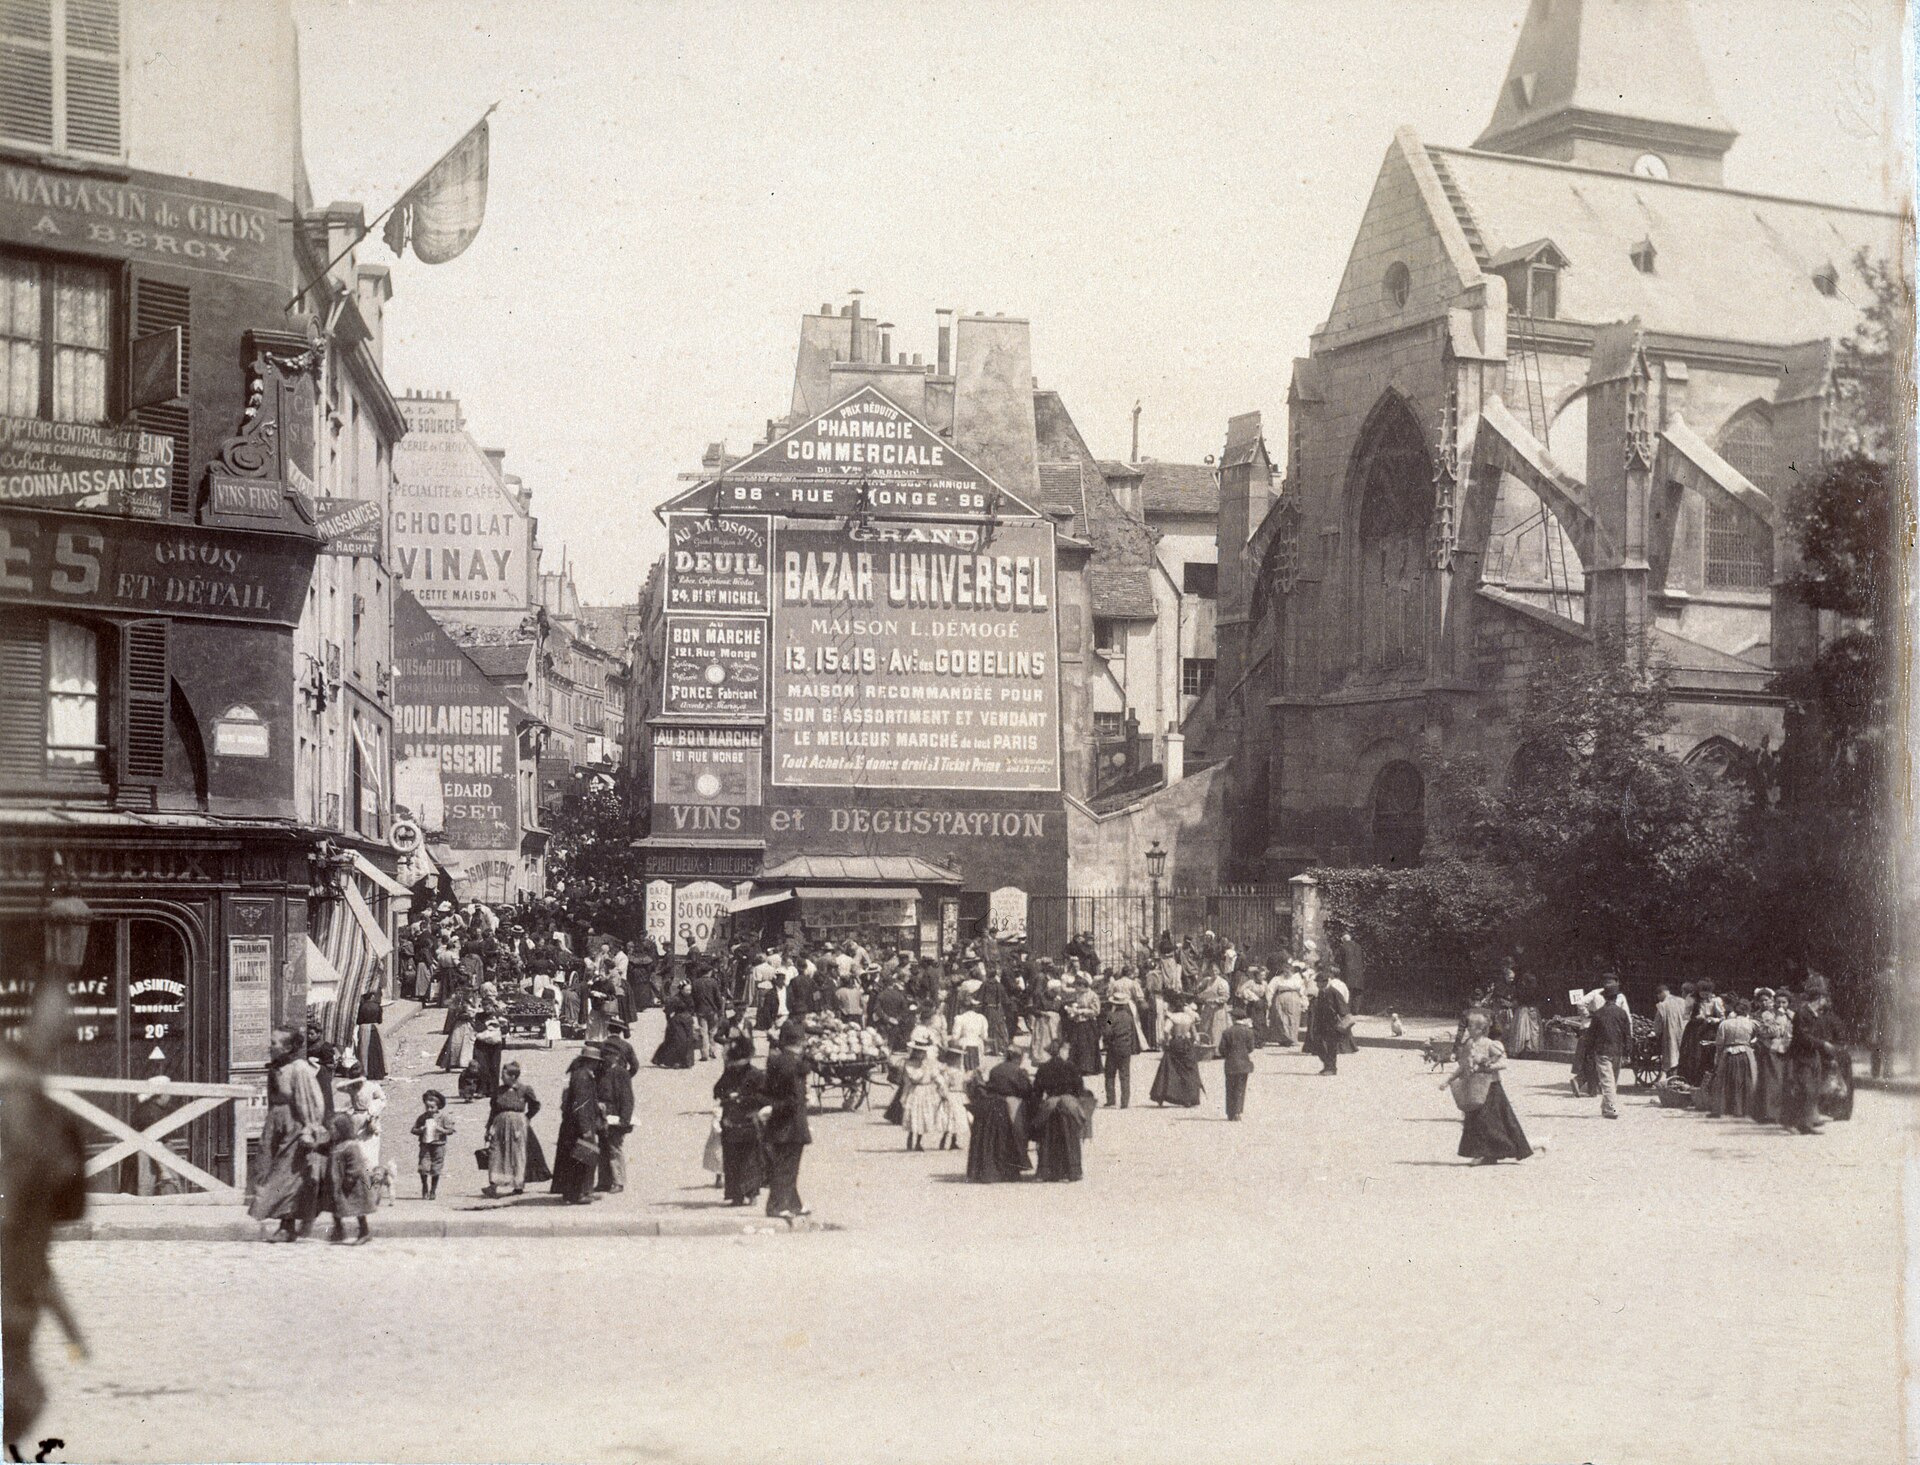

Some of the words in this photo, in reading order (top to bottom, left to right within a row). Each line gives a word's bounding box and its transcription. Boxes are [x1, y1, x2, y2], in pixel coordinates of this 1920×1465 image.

[4, 170, 147, 221] MAGASIN
[155, 202, 179, 228] de
[188, 204, 266, 243] GROS
[840, 403, 861, 419] PRIX
[863, 401, 899, 420] RÉDUITS
[54, 423, 103, 447] CENTRAL
[817, 419, 913, 439] PHARMACIE
[787, 440, 944, 466] COMMERCIALE
[817, 466, 831, 474] DU
[217, 484, 246, 508] VINS
[249, 486, 280, 510] FINS
[792, 489, 834, 502] RUE
[395, 511, 513, 537] CHOCOLAT
[674, 527, 692, 546] AU
[694, 518, 766, 548] MOSOTIS
[849, 528, 979, 545] GRAND
[155, 538, 242, 574] GROS
[336, 540, 375, 554] RACHAT
[397, 547, 512, 581] VINAY
[674, 551, 765, 576] DEUIL
[116, 573, 156, 600] ET
[784, 551, 874, 602] BAZAR
[888, 552, 1048, 608] UNIVERSEL
[419, 589, 447, 600] CETTE
[453, 590, 497, 601] MAISON
[719, 591, 761, 605] MICHEL
[673, 628, 700, 643] BON
[706, 627, 761, 645] MARCHÉ
[811, 619, 898, 635] MAISON
[696, 647, 716, 658] Rue
[720, 648, 757, 662] Monge
[816, 646, 838, 671] 15
[854, 647, 877, 672] 19
[935, 650, 1045, 675] GOBELINS
[718, 687, 757, 700] Fabricant
[788, 685, 854, 698] MAISON
[865, 685, 992, 701] RECOMMANDÉE
[1001, 688, 1043, 702] POUR
[394, 705, 510, 736] BOULANGERIE
[783, 708, 815, 723] SON
[843, 708, 950, 726] ASSORTIMENT
[956, 711, 973, 726] ET
[980, 711, 1047, 728] VENDANT
[657, 729, 674, 746] AU
[678, 729, 704, 746] BON
[794, 732, 811, 746] LE
[817, 732, 889, 748] MEILLEUR
[896, 731, 959, 749] MARCHÉ
[960, 737, 972, 749] de
[973, 736, 991, 750] tout
[993, 734, 1038, 750] PARIS
[672, 751, 684, 762] 121
[688, 751, 707, 762] RUE
[712, 751, 744, 763] MONGE
[782, 754, 808, 769] Tout
[809, 754, 845, 769] Achat
[901, 755, 927, 771] droit
[941, 756, 970, 772] Ticket
[670, 805, 741, 831] VINS
[770, 808, 804, 832] et
[829, 808, 1045, 838] DEGUSTATION
[650, 902, 667, 912] 10
[678, 902, 693, 919] 50
[697, 902, 712, 919] 60
[678, 922, 708, 940] 80
[233, 944, 267, 954] TRIANON
[66, 975, 108, 996] CAFÉ
[129, 978, 186, 997] ABSINTHE
